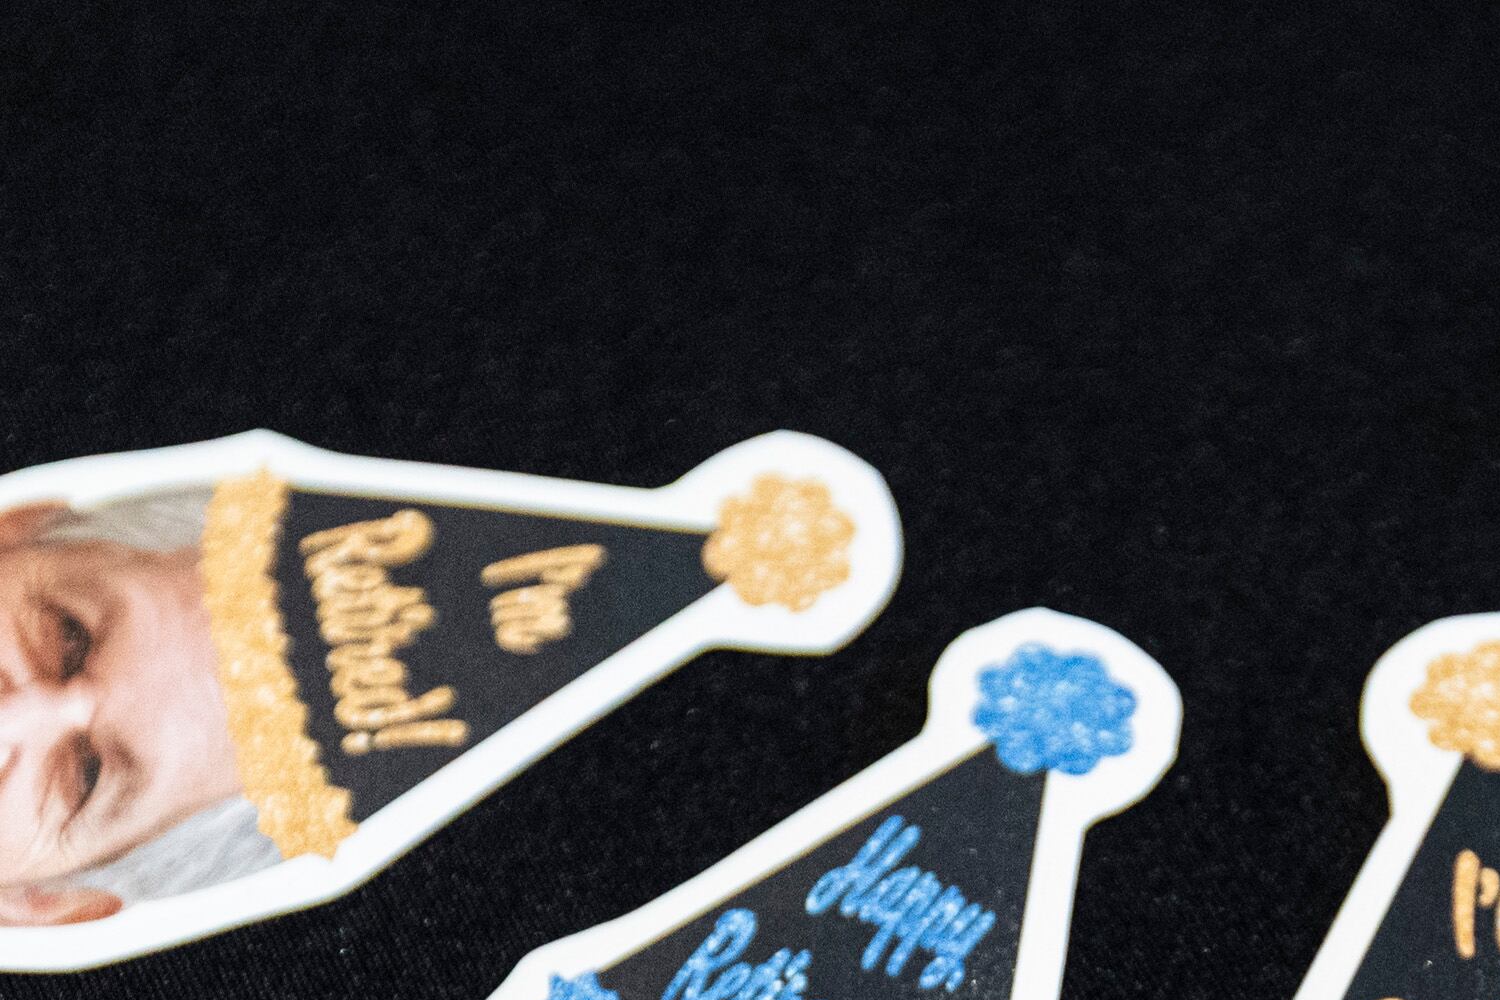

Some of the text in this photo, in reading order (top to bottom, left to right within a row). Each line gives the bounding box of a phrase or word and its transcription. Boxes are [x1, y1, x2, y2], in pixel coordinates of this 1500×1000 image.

[299, 509, 471, 755] Retired!
[480, 543, 606, 656] I'm
[806, 815, 996, 993] Happy
